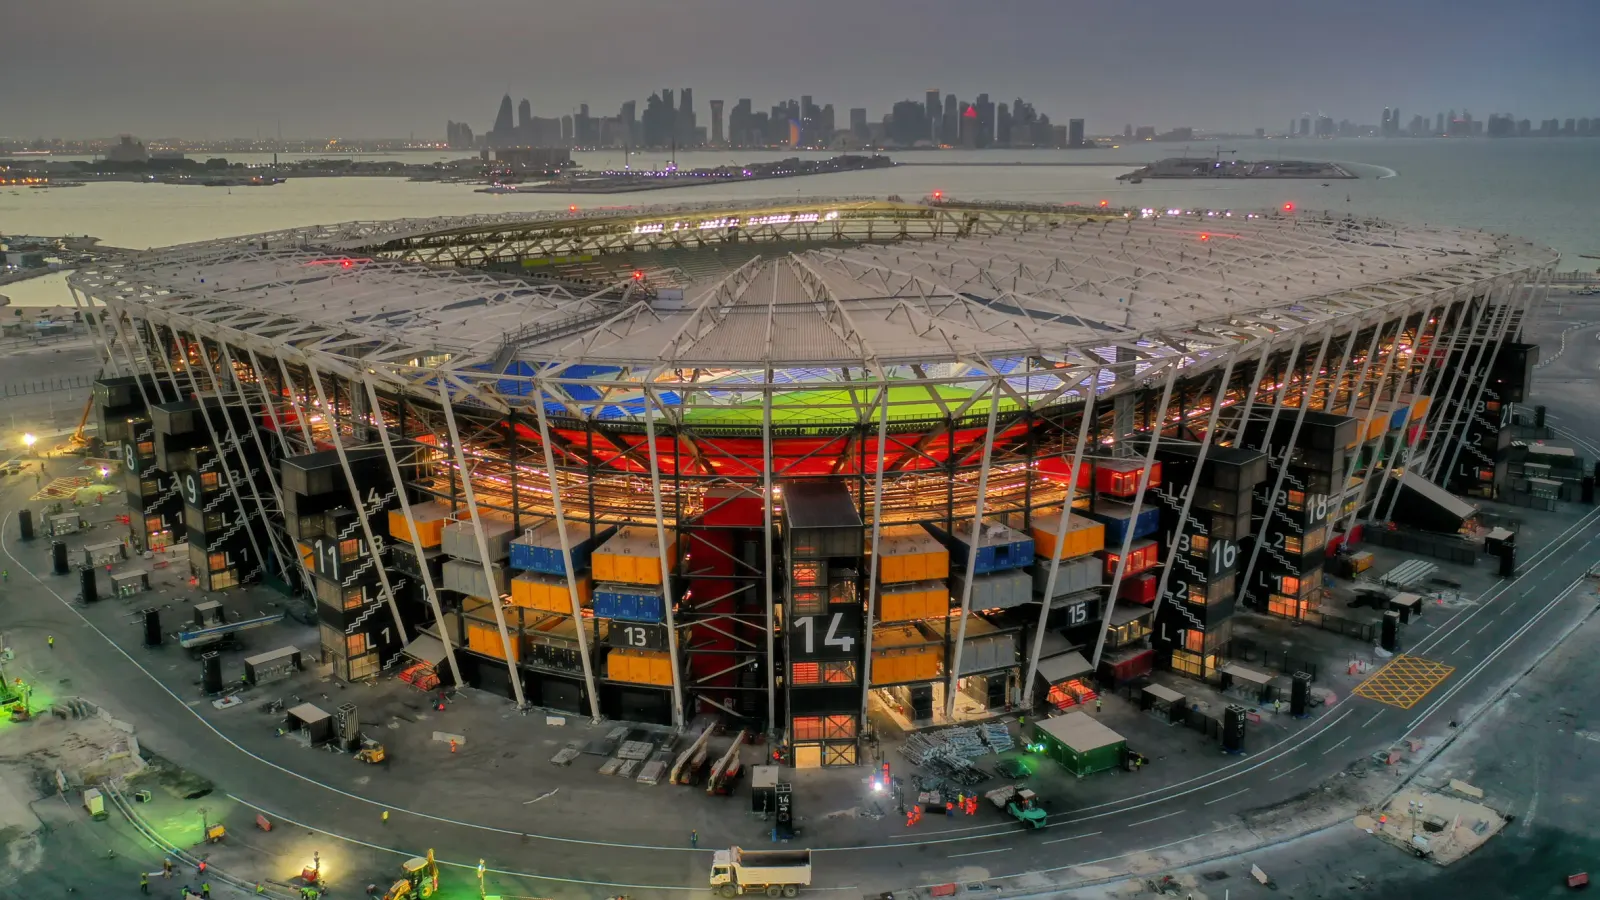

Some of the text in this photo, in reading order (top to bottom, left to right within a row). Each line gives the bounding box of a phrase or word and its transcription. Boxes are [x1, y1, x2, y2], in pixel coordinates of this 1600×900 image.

[1500, 402, 1513, 428] 21
[125, 443, 135, 470] 8
[186, 474, 196, 504] 9
[1307, 494, 1328, 524] 18
[315, 539, 338, 581] 11
[1212, 539, 1236, 574] 16
[1068, 603, 1086, 624] 15
[624, 626, 646, 647] 13
[794, 612, 855, 653] 14
[1238, 713, 1245, 721] 15
[778, 795, 789, 804] 14
